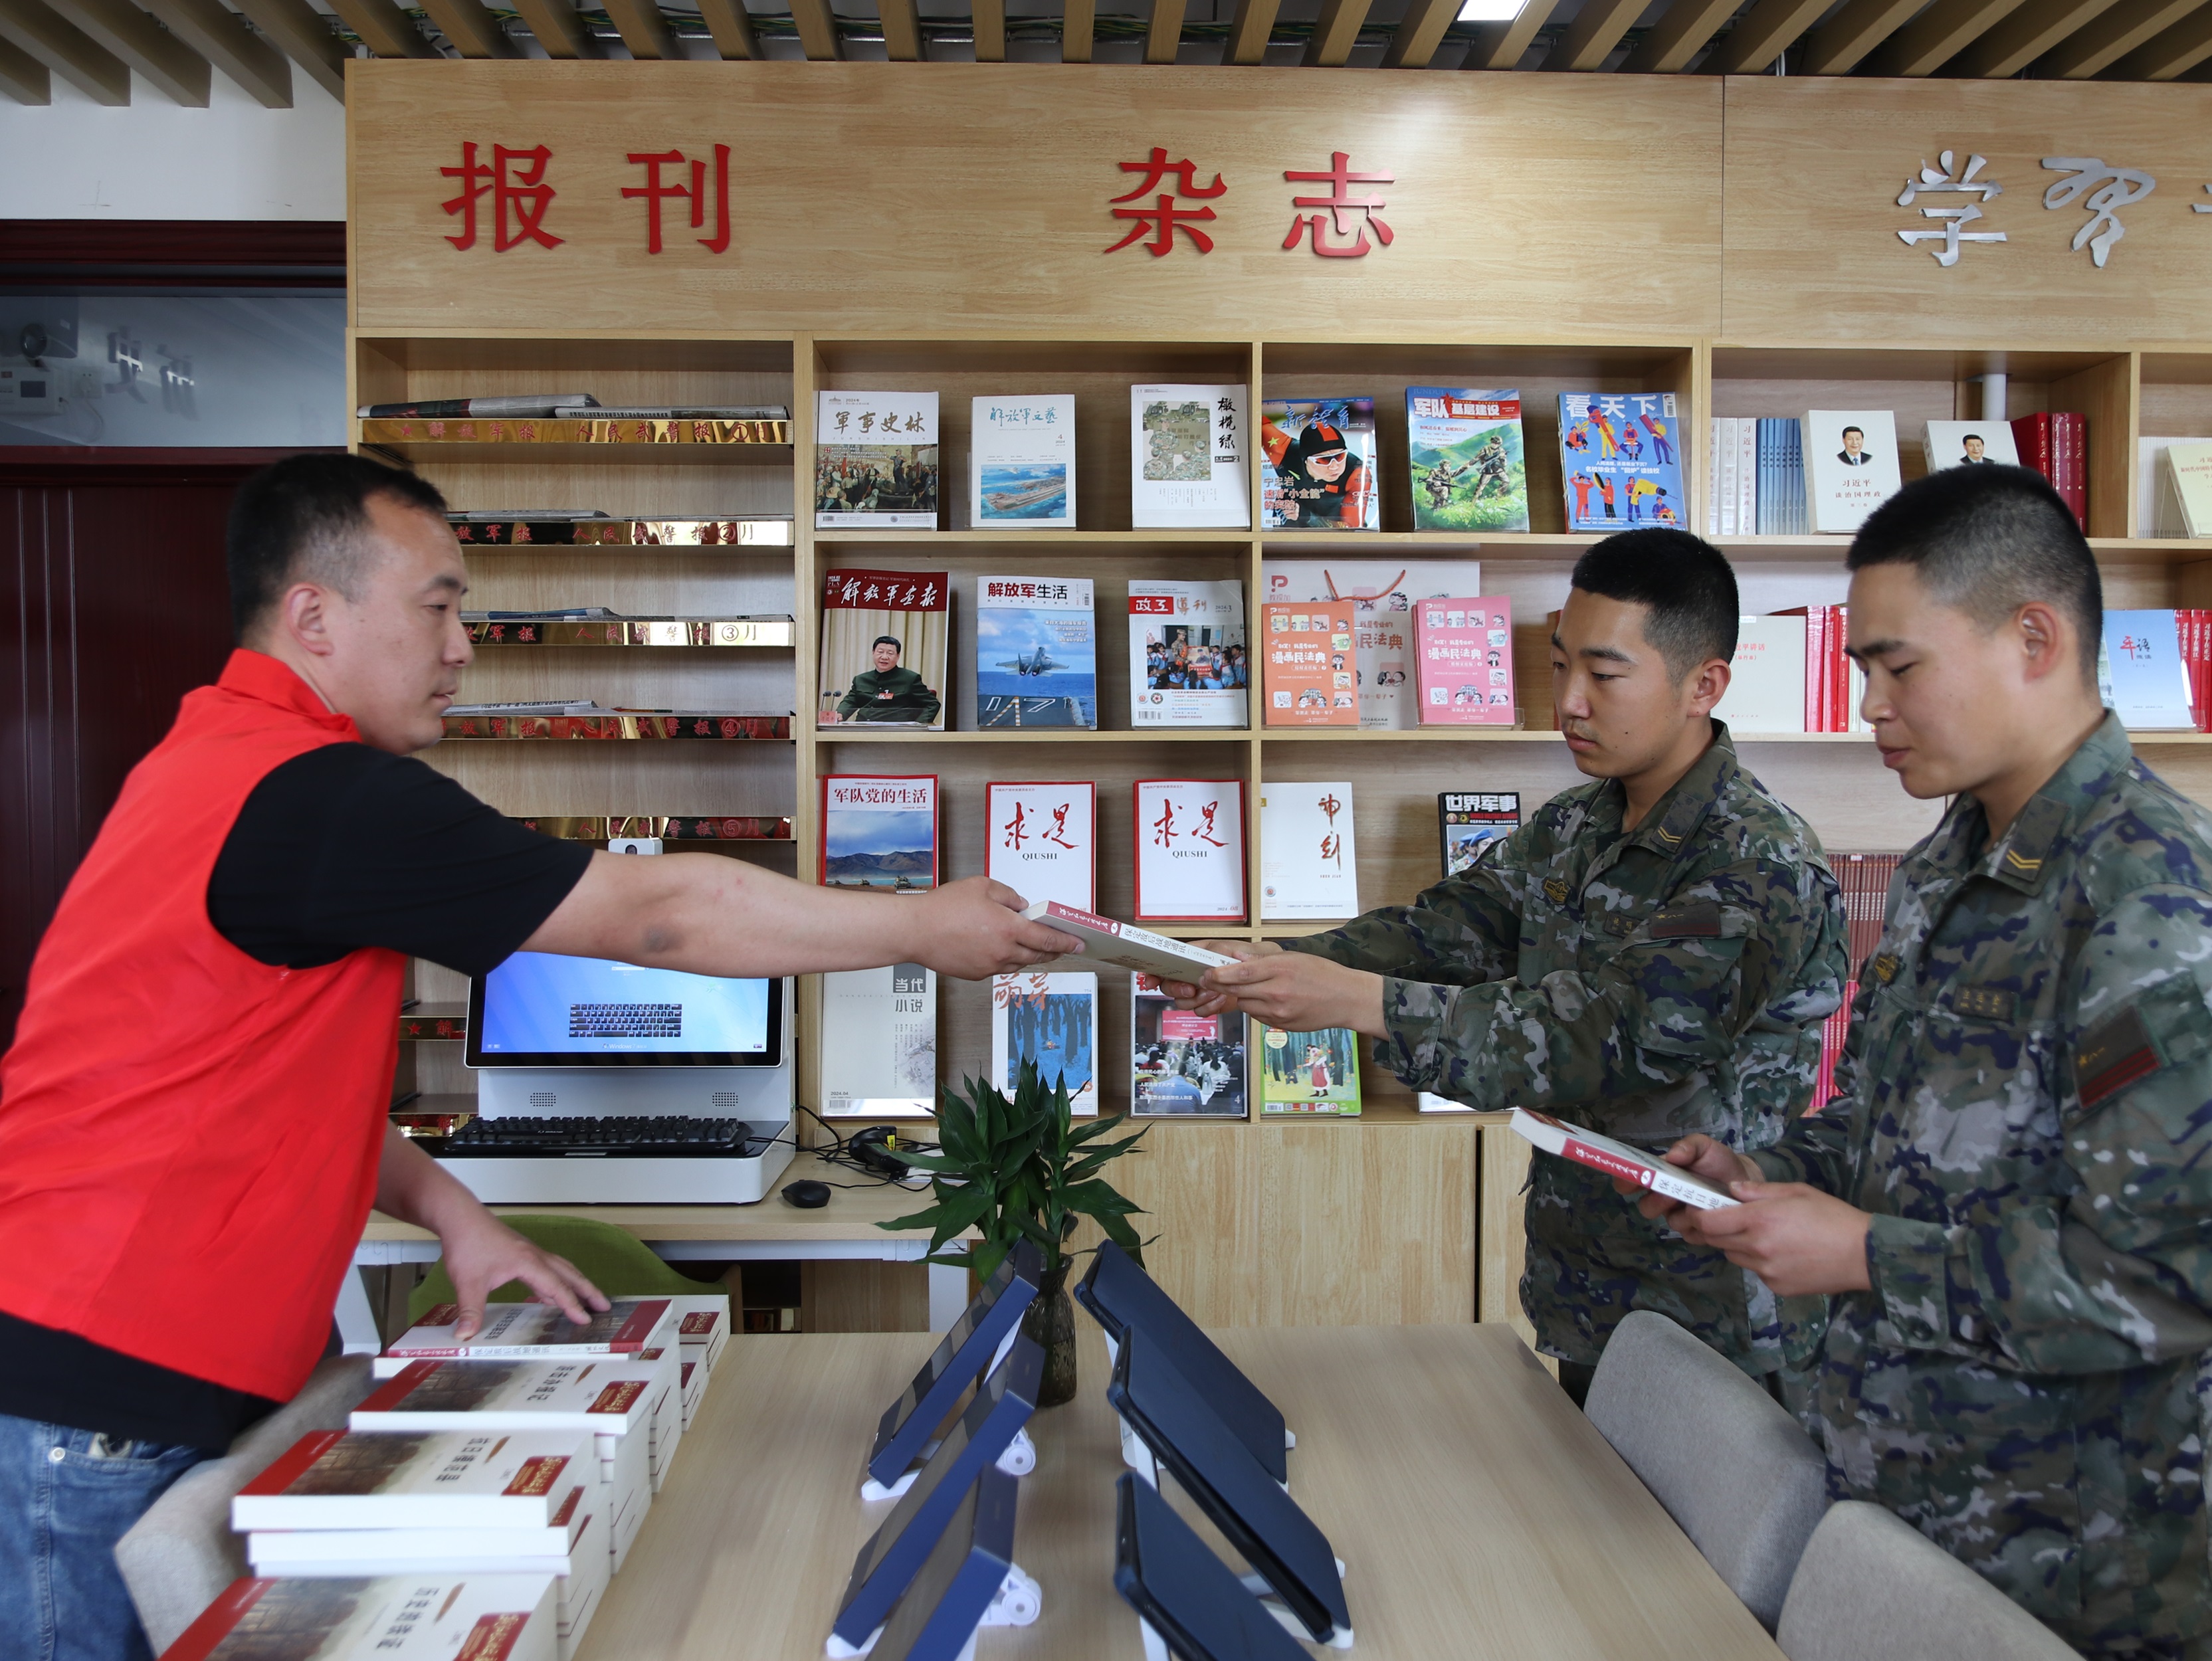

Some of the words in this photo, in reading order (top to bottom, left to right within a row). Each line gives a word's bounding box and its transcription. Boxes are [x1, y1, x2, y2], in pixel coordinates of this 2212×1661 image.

[439, 140, 731, 254] 报刊
[1104, 147, 1395, 257] 杂志
[1897, 150, 2212, 268] 学习
[1413, 397, 1449, 419] 军队
[1452, 403, 1500, 416] 基层建设
[1565, 395, 1657, 419] 看天下
[988, 583, 1068, 599] 解放军生活
[1355, 633, 1403, 650] 民法典
[1272, 651, 1326, 664] 漫画民法典
[1428, 647, 1482, 660] 漫画民法典
[834, 788, 927, 804] 军队党的生活
[1445, 795, 1517, 812] 世界军事
[1005, 802, 1080, 851] 求是
[1154, 799, 1229, 848] 求是
[895, 978, 924, 991] 当代
[895, 999, 923, 1013] 小说
[1234, 1095, 1241, 1104] 4
